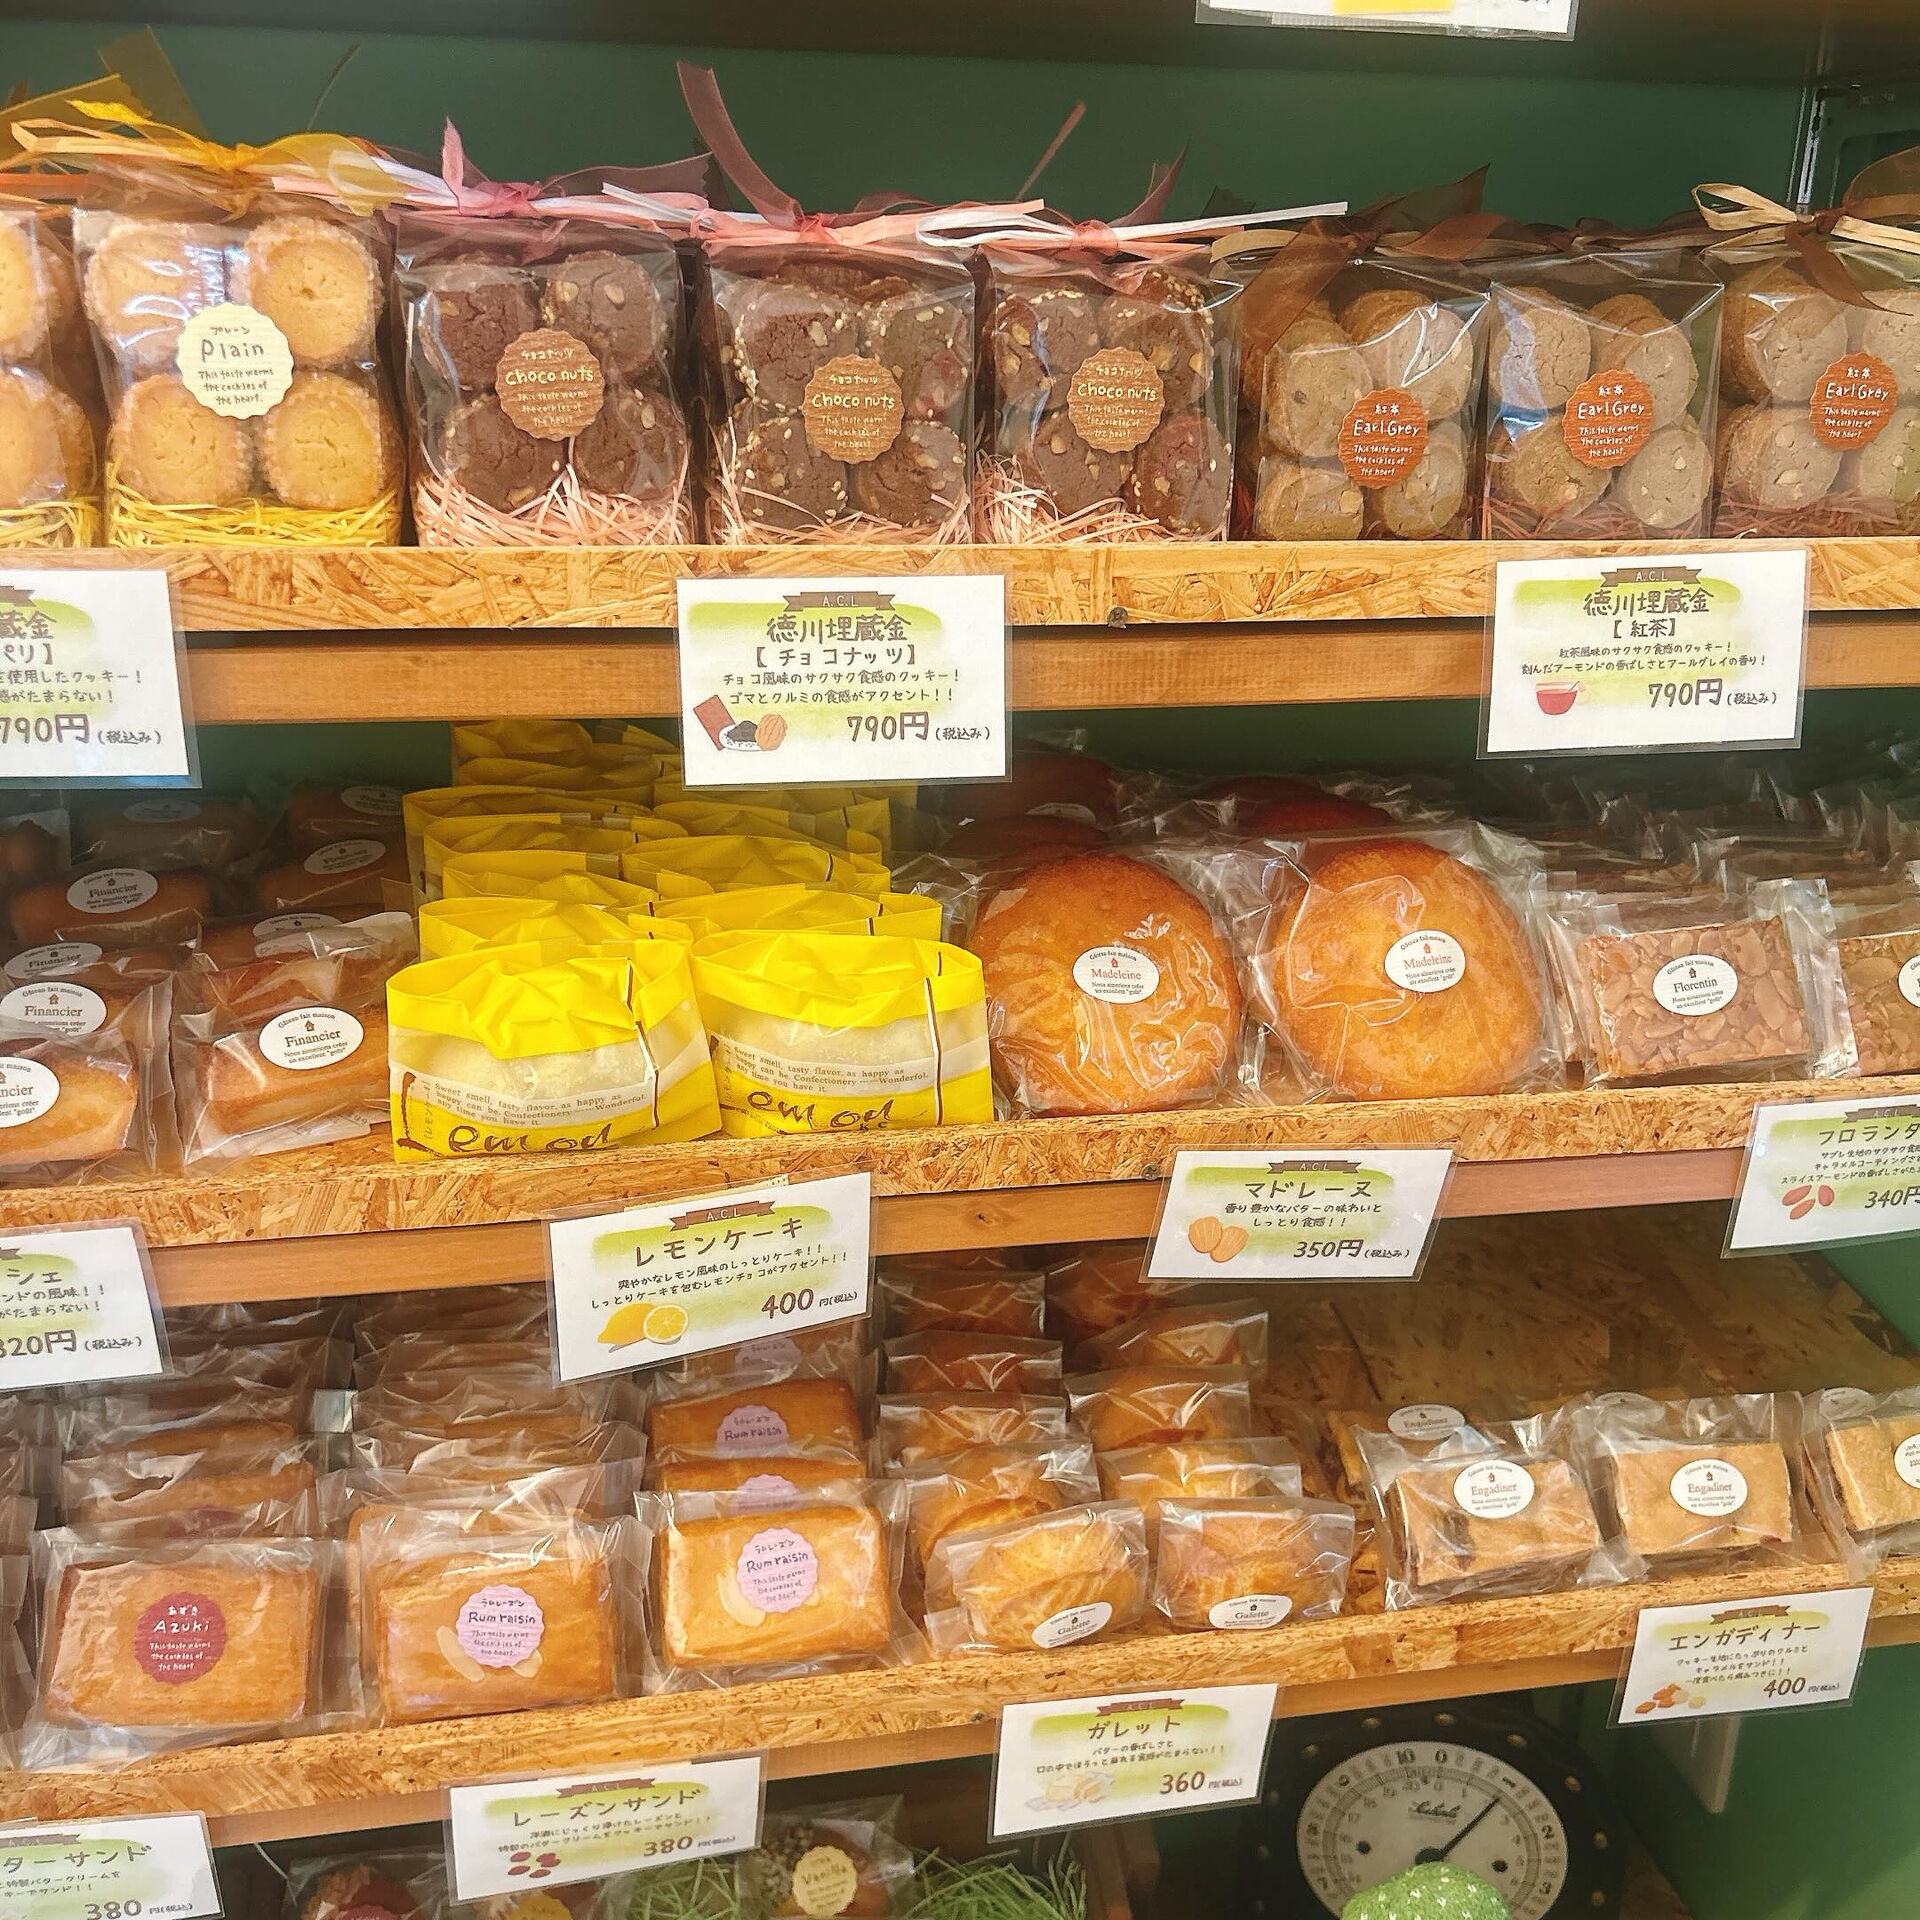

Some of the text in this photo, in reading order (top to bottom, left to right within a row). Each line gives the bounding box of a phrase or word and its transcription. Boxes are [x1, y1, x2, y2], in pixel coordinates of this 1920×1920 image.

[201, 339, 264, 363] Plain
[198, 368, 274, 380] This taste warms
[561, 365, 594, 382] nuts
[204, 381, 267, 391] the of
[1128, 387, 1157, 402] nuts
[1826, 383, 1888, 400] Earl Grey
[216, 396, 231, 405] the
[864, 394, 895, 409] nuts
[1578, 401, 1644, 419] Earl Grey
[1354, 419, 1420, 437] Earl Grey
[1579, 427, 1595, 435] This
[1597, 426, 1615, 434] taste
[1354, 444, 1368, 454] This
[1581, 435, 1633, 446] the of
[1589, 449, 1600, 457] the
[1583, 588, 1714, 617] 徳川埋蔵金
[766, 613, 912, 644] 徳川埋蔵金
[1612, 617, 1678, 639] 【紅茶】
[755, 645, 916, 669] 【チョコナッツ】
[88, 884, 138, 898] Financier
[1403, 955, 1452, 970] Madeleine
[1091, 969, 1142, 980] Madeleine
[1673, 977, 1718, 993] Florentin
[24, 1005, 83, 1017] Financier
[285, 1030, 341, 1048] Financier
[752, 1071, 813, 1091] time you have
[761, 1067, 774, 1075] can
[794, 1074, 857, 1087] Confectionery
[788, 1066, 809, 1075] tasty
[862, 1070, 889, 1079] happy
[435, 1083, 461, 1096] Sweet
[499, 1100, 520, 1112] tasty
[577, 1096, 604, 1107] happy
[456, 1106, 476, 1117] time
[481, 1115, 497, 1123] you
[504, 1117, 525, 1125] have
[466, 1103, 482, 1111] can
[1245, 1180, 1371, 1199] マドレーヌ
[1225, 1203, 1382, 1214] 香り豊かなバターの味わいと
[636, 1217, 803, 1267] レモンケーキ
[761, 1289, 814, 1320] 400
[724, 1427, 782, 1440] Rum raisin
[1471, 1483, 1517, 1498] Engadiner
[1688, 1482, 1732, 1494] Engadiner
[746, 1552, 809, 1573] Rum raisin
[468, 1611, 536, 1624] Rum raisin
[1235, 1611, 1269, 1619] Galette
[153, 1620, 209, 1633] Azuki
[1669, 1622, 1821, 1651] エンガディナー
[1764, 1677, 1806, 1698] 400
[1088, 1715, 1180, 1740] ガレット
[1160, 1771, 1205, 1794] 360
[514, 1789, 701, 1827] レーズンサンド
[643, 1835, 693, 1856] 380
[4, 1845, 152, 1873] ターサンド
[84, 1899, 142, 1920] 380
